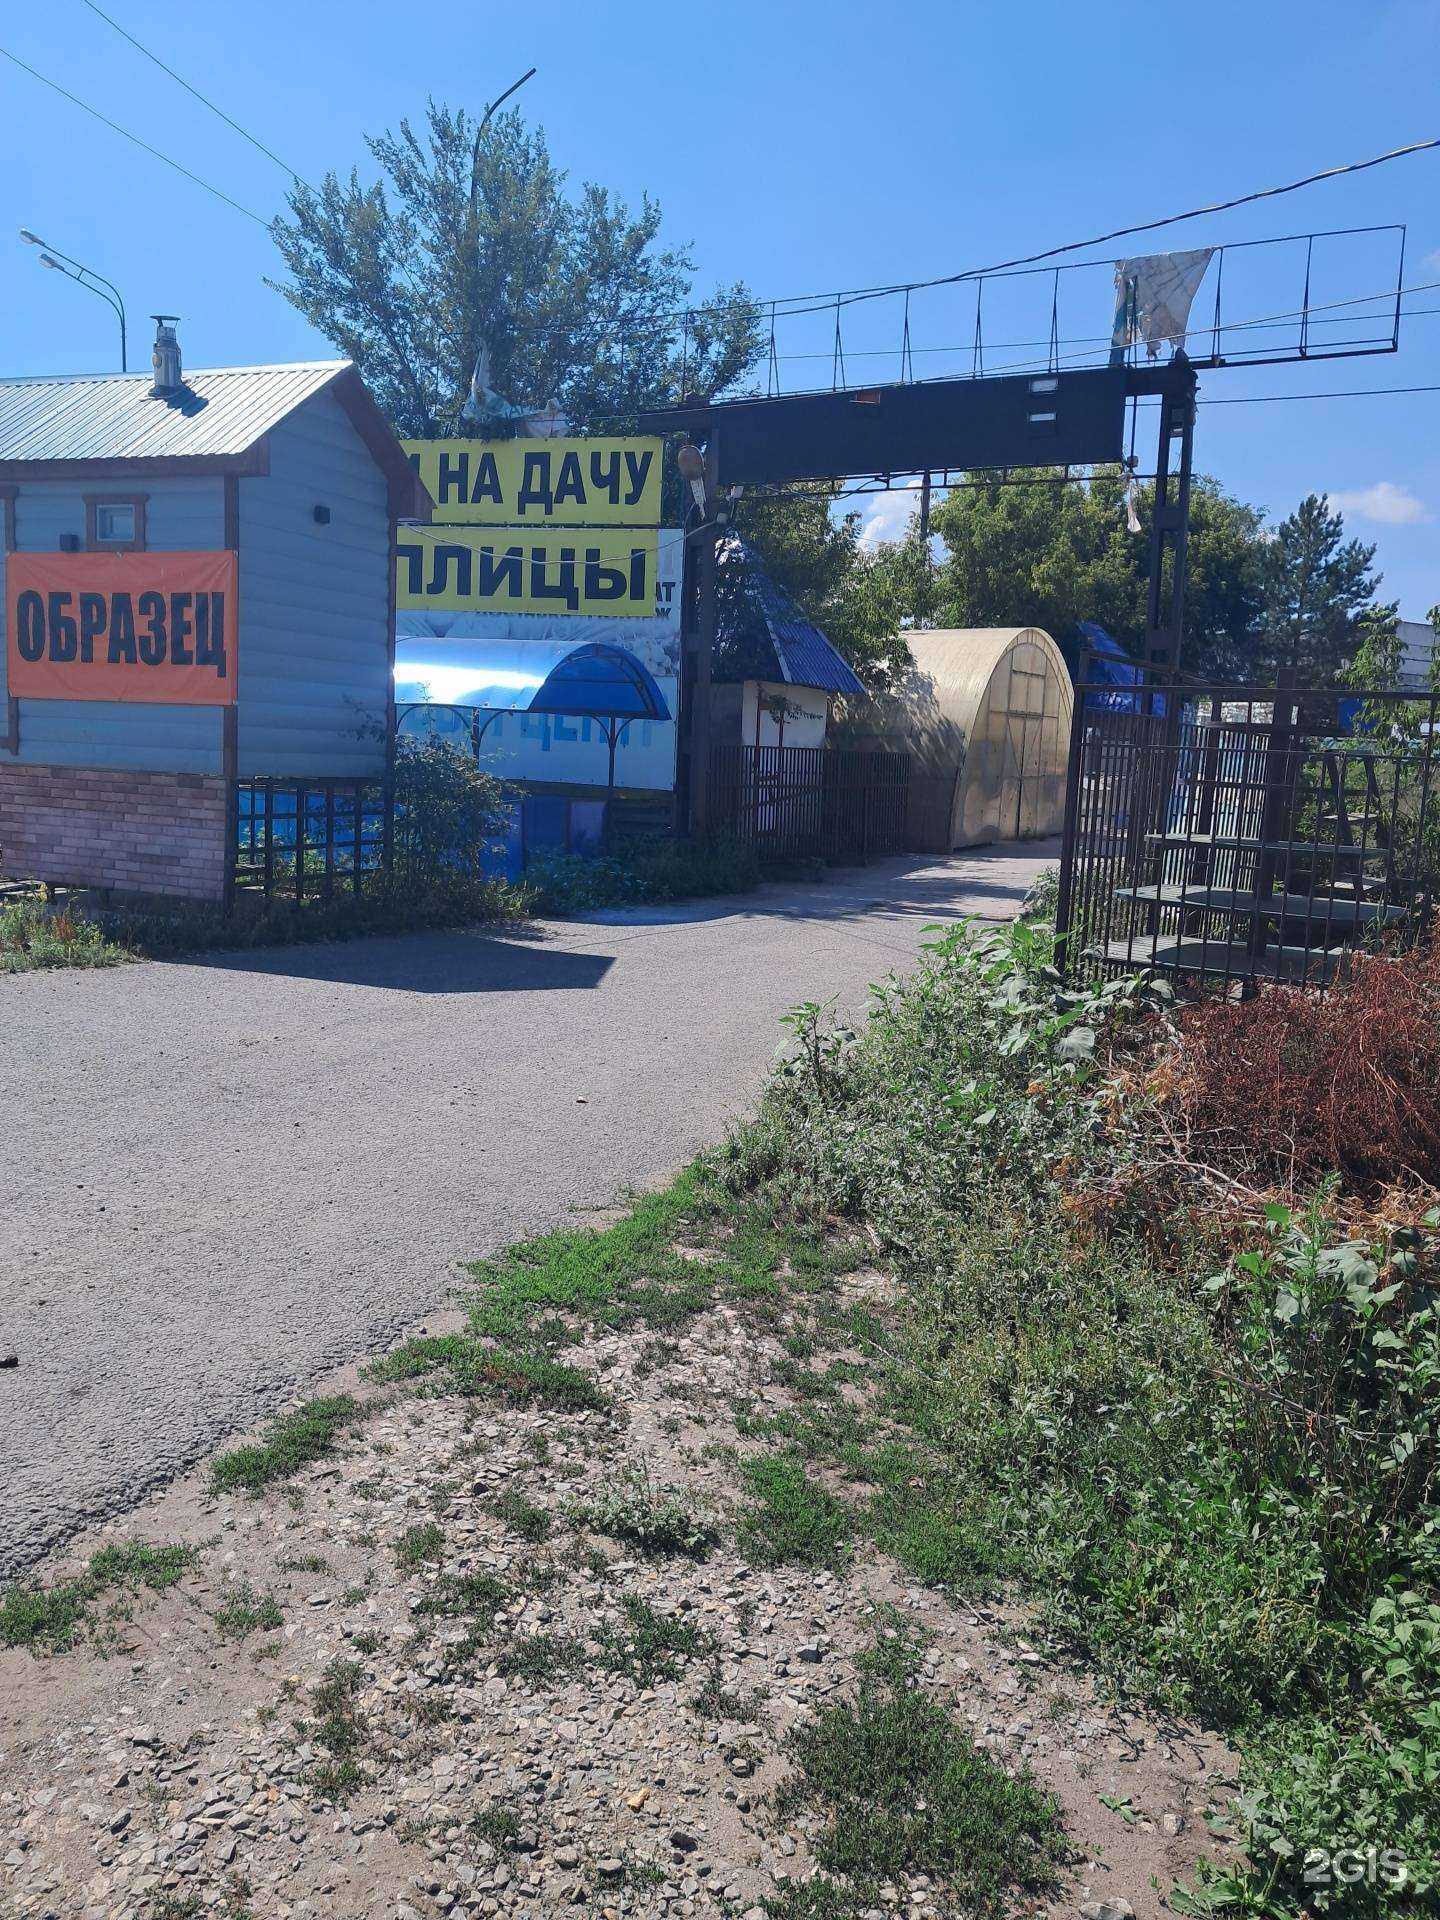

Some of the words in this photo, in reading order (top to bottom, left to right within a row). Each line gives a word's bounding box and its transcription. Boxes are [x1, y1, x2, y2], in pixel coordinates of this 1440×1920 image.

[438, 452, 504, 504] НА
[517, 451, 654, 515] ДАЧУ
[16, 589, 227, 678] ОБРАЗЕЦ
